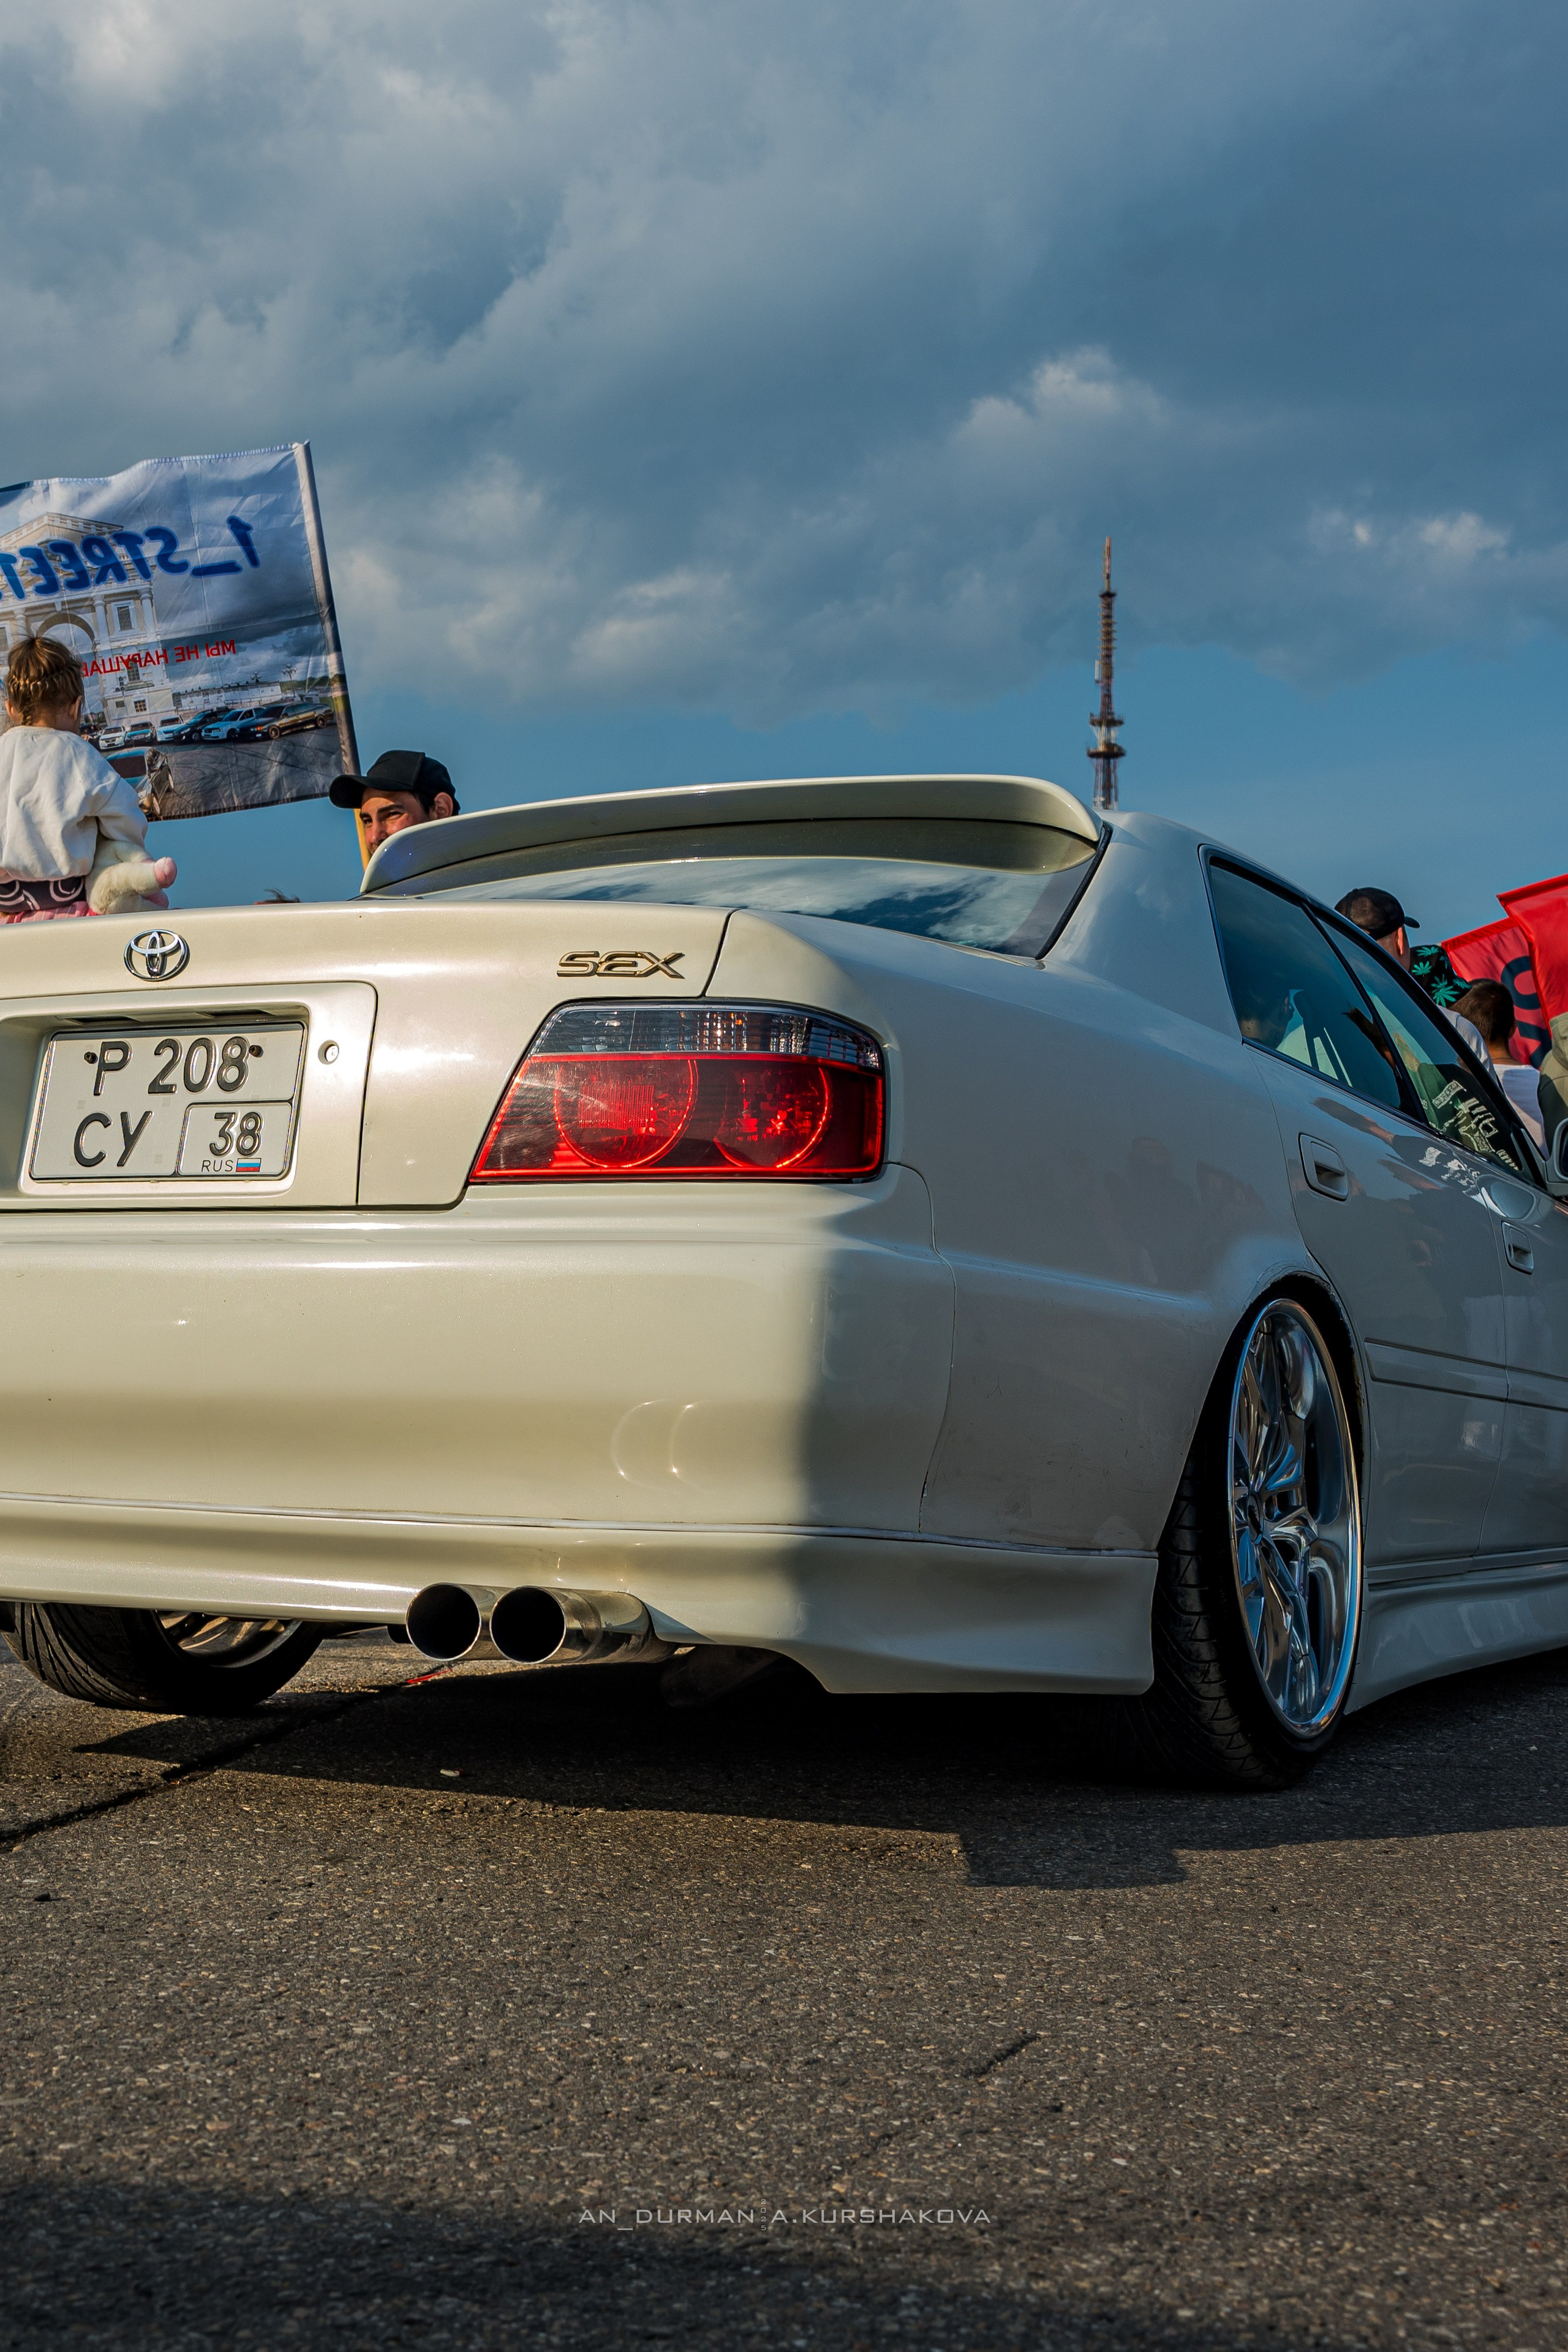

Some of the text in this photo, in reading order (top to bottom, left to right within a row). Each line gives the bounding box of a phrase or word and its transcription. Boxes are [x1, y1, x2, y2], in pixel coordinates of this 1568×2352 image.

[556, 950, 685, 979] SEX
[148, 1036, 251, 1095] 208
[74, 1110, 155, 1167] СУ
[209, 1111, 263, 1157] 38
[201, 1159, 233, 1173] RUS
